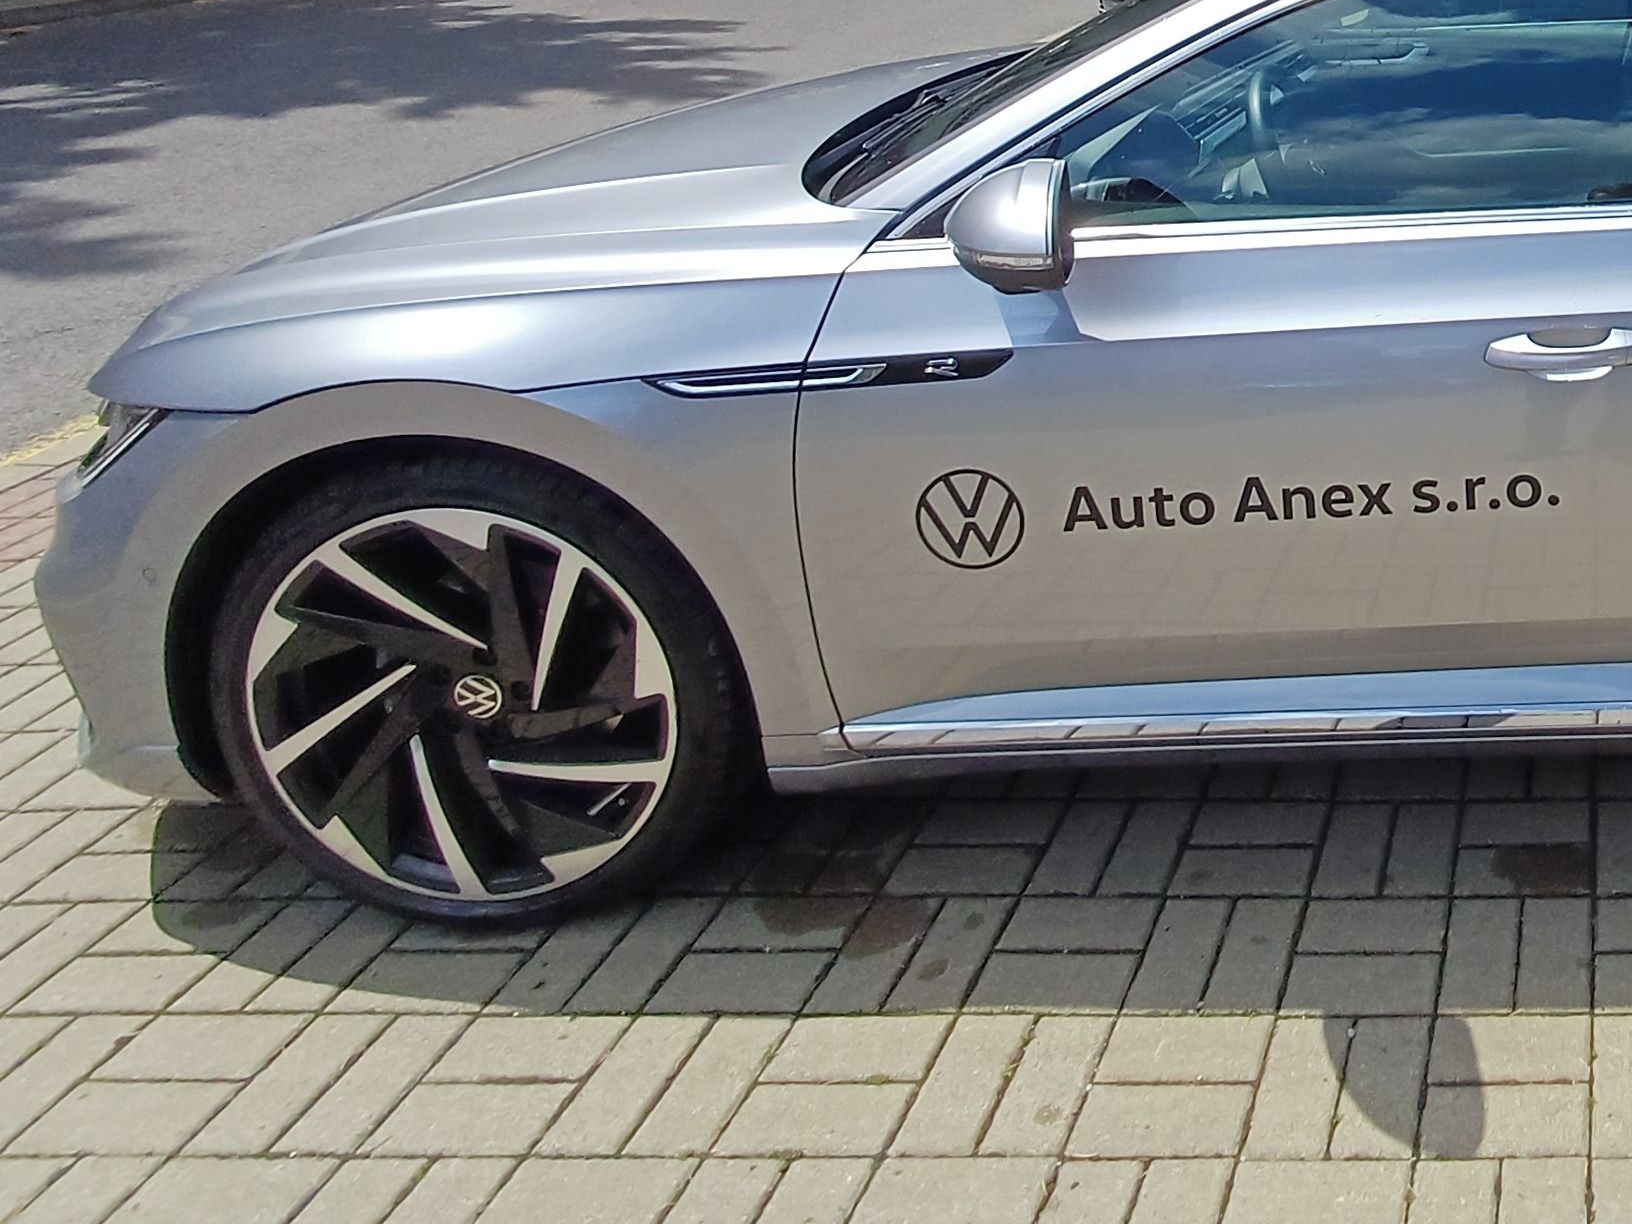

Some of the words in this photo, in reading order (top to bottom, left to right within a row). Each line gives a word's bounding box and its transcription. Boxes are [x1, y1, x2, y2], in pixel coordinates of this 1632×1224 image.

[1063, 484, 1216, 533] Auto
[1233, 475, 1394, 524] Anex
[1411, 472, 1562, 516] s.r.o.
